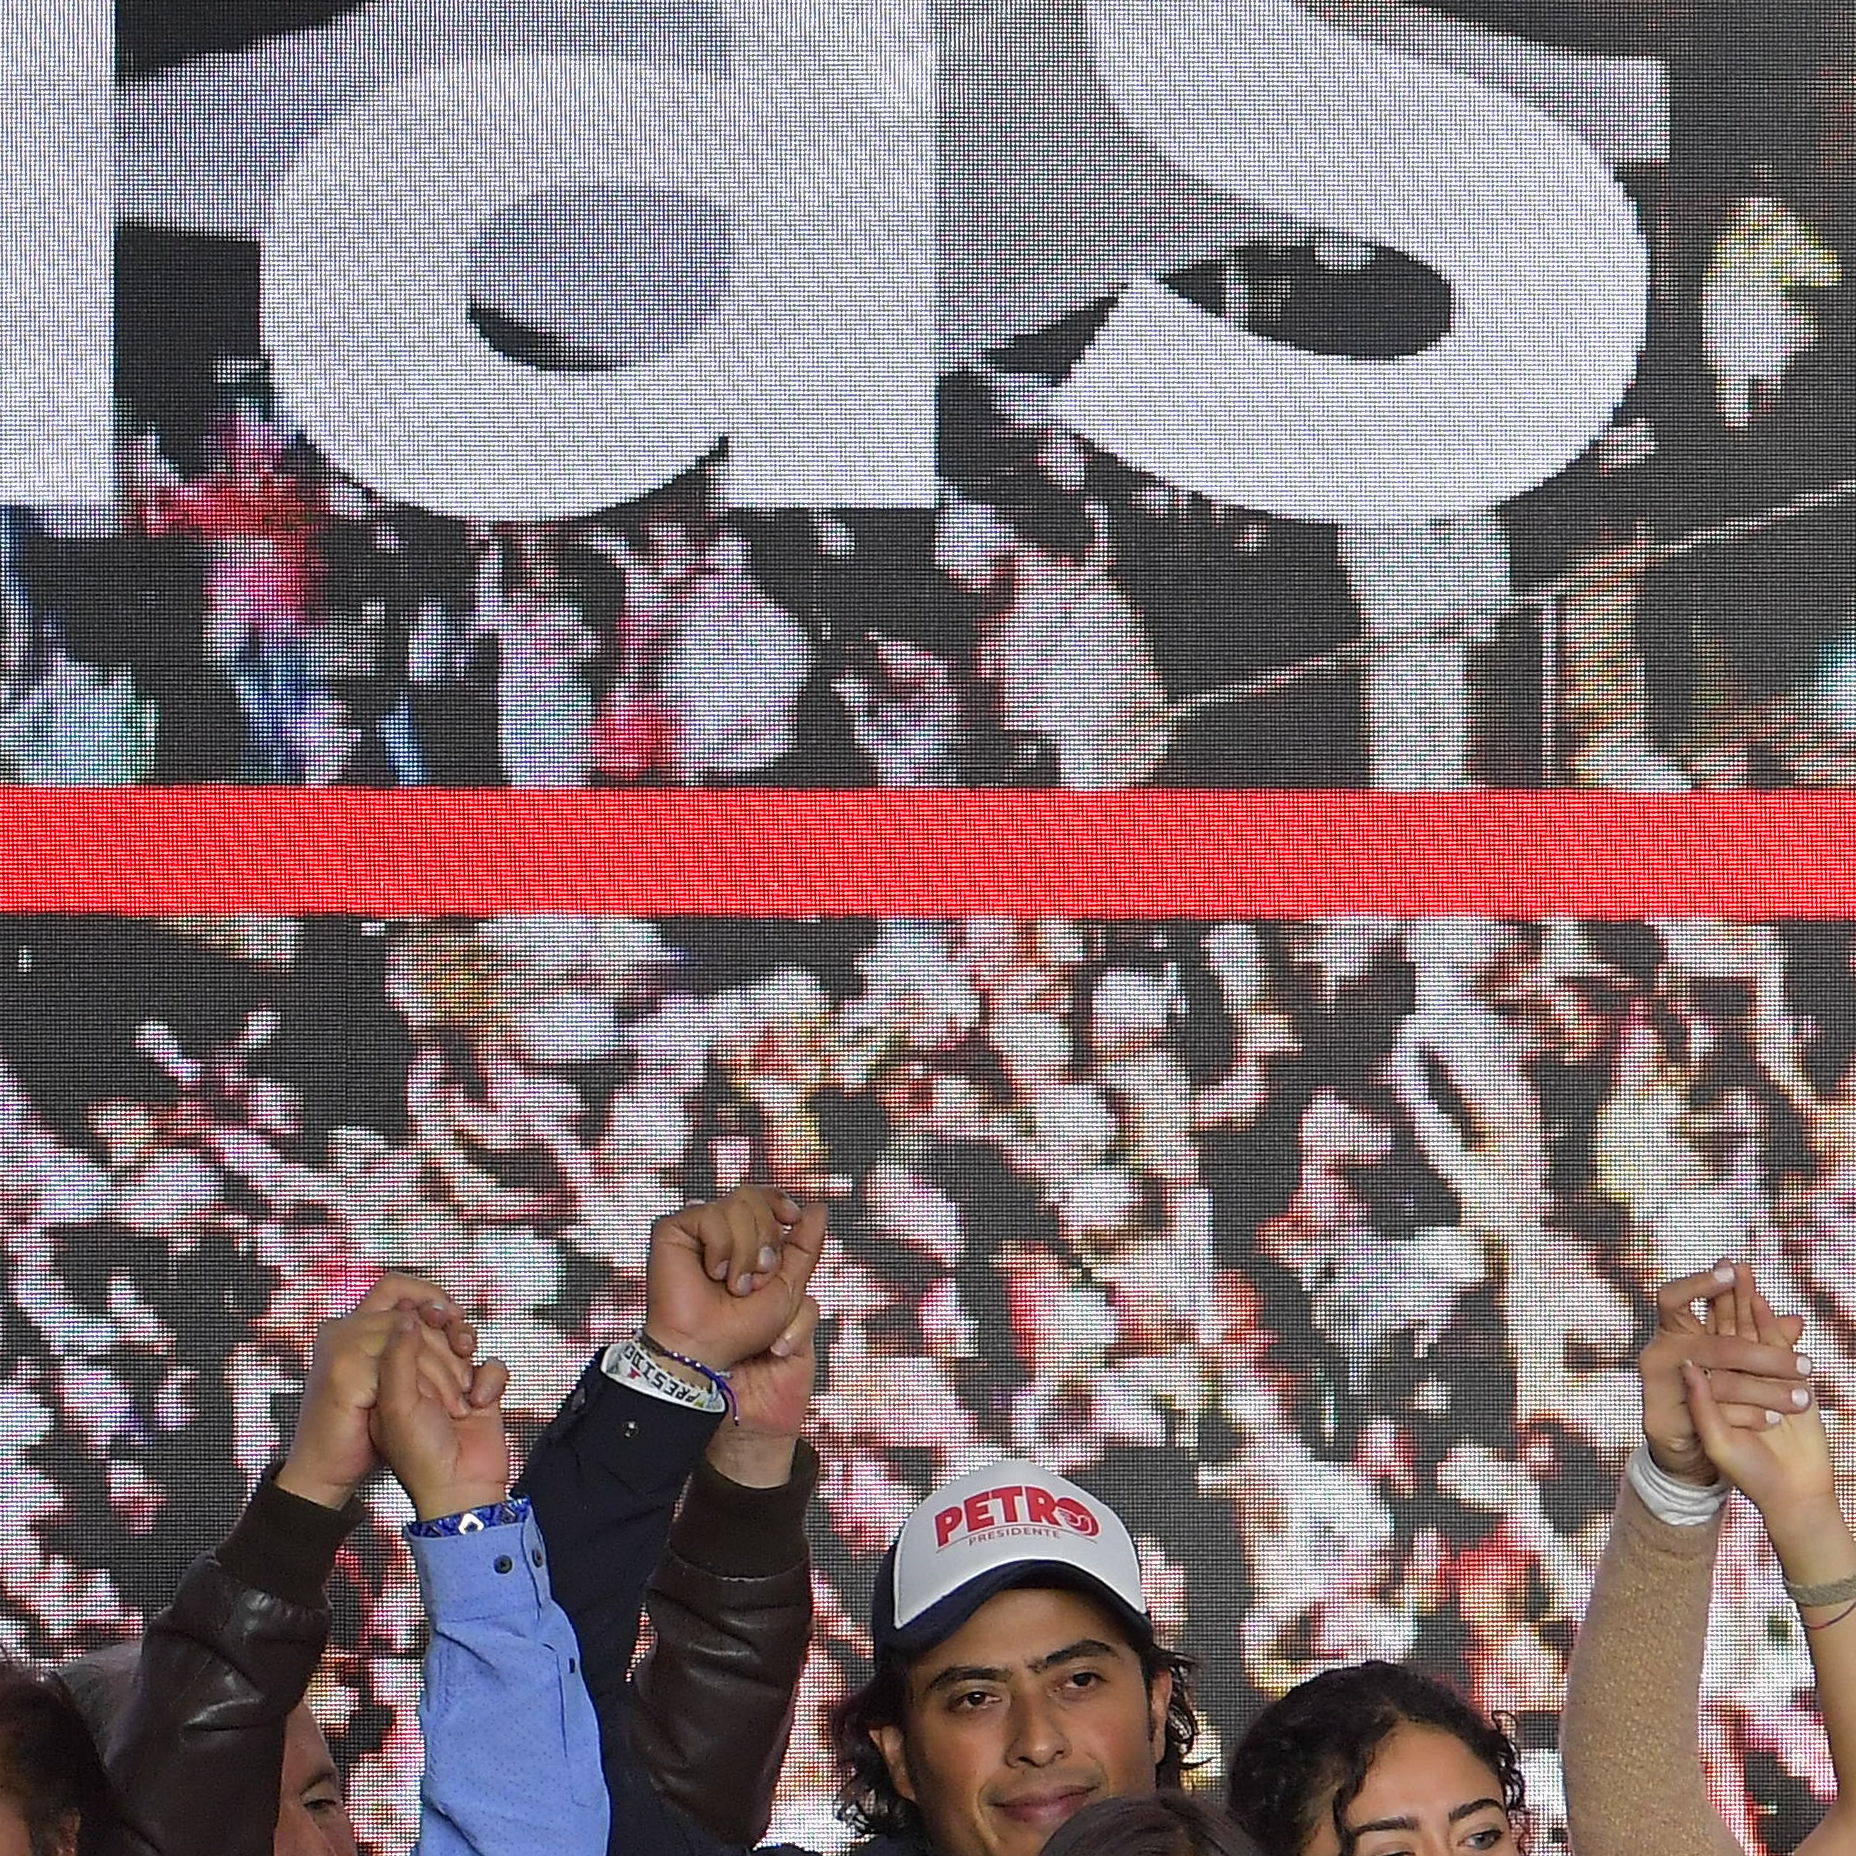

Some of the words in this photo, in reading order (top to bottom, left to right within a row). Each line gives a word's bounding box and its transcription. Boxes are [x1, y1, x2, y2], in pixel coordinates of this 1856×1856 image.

[623, 1344, 700, 1403] PRESIDE
[933, 1484, 1101, 1549] PETRO
[967, 1525, 1062, 1547] PRESIDENTE
